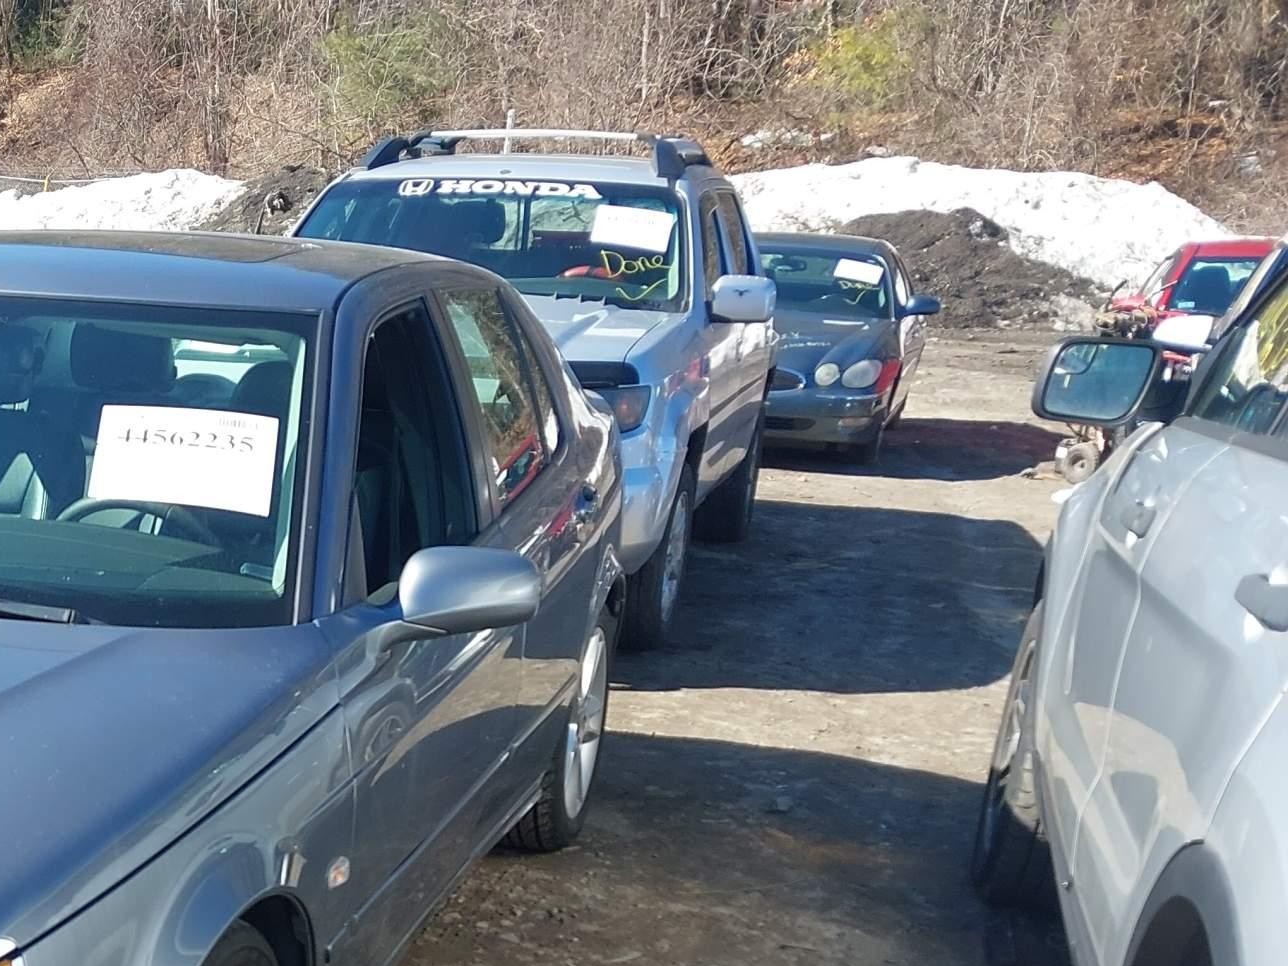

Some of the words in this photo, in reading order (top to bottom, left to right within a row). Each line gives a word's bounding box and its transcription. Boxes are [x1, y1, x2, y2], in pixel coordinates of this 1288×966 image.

[436, 179, 603, 200] HONDA
[600, 249, 673, 279] Done
[117, 427, 254, 453] 44562235
